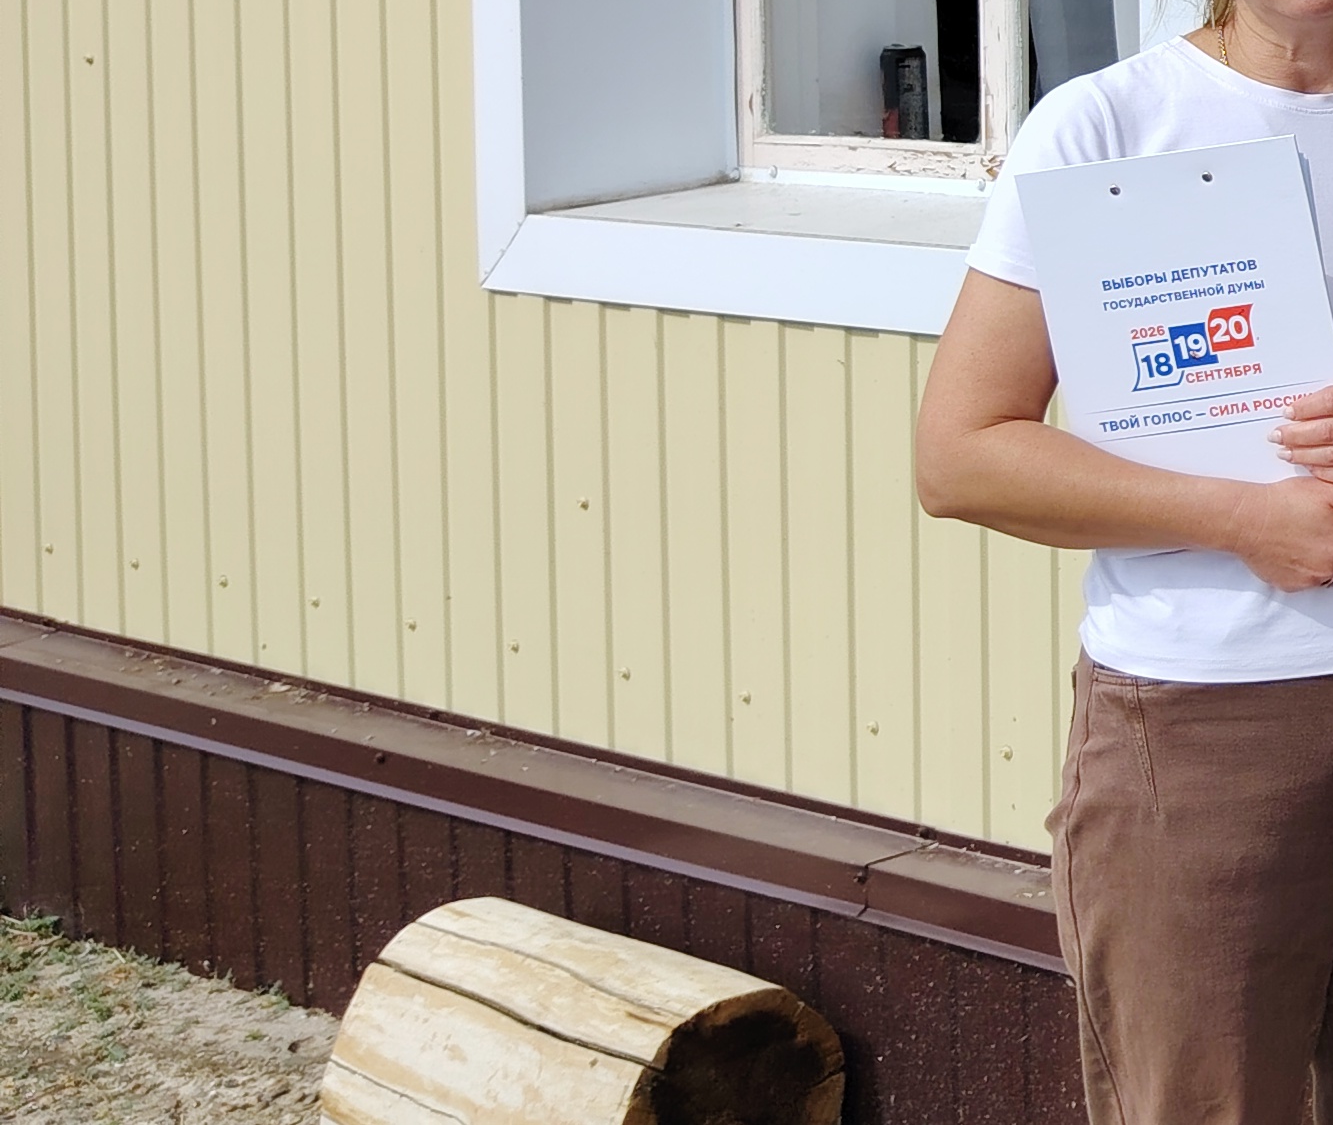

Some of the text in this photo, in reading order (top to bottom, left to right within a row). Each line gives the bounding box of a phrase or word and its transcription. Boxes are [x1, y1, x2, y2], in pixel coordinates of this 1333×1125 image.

[1101, 259, 1258, 291] ВЫБОРЫ ДЕПУТАТОВ
[1103, 279, 1265, 311] ГОСУДАРСТВЕННОЙ ДУМЫ
[1130, 325, 1166, 340] 2026
[1141, 314, 1249, 378] 18 19 20
[1185, 362, 1263, 384] СЕНТЯБРЯ
[1099, 415, 1140, 433] ТВОЙ
[1143, 410, 1193, 428] ГОЛОС
[1209, 402, 1250, 418] СИЛА
